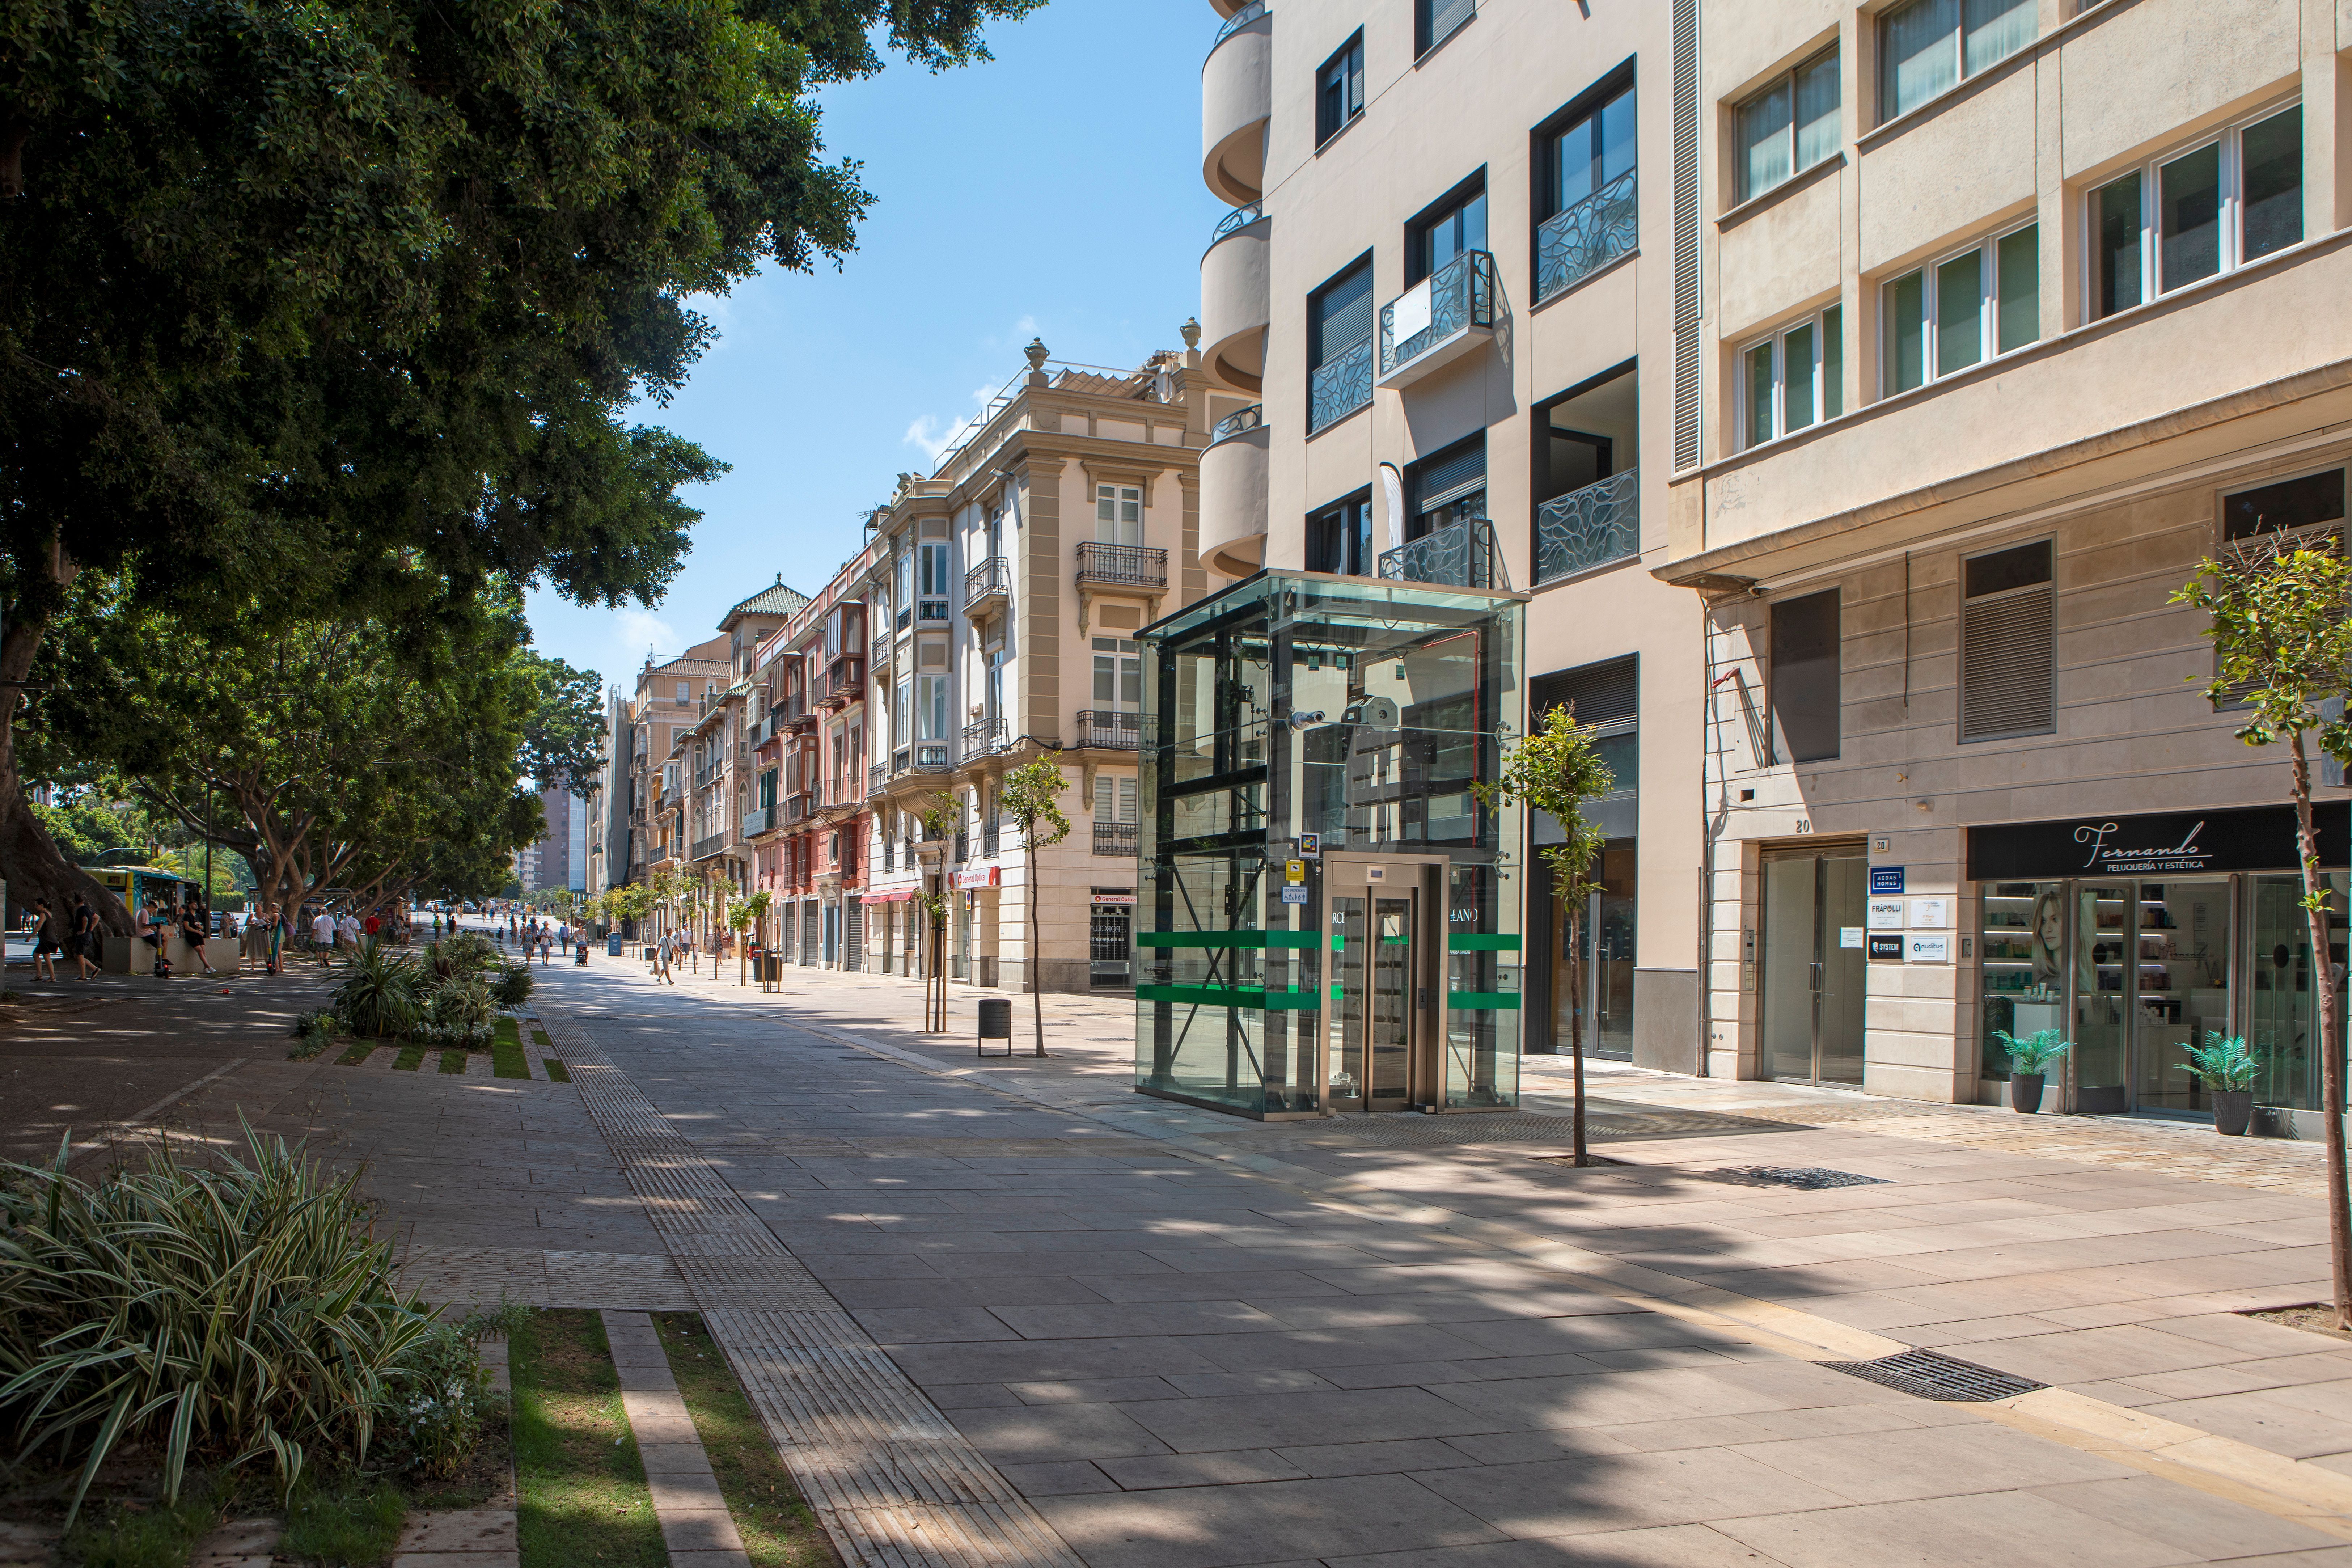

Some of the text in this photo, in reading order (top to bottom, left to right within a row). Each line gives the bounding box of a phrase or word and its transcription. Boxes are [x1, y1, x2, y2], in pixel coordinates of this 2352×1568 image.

[1796, 820, 1809, 833] 20
[2074, 821, 2204, 867] Fernando
[2107, 860, 2156, 871] PELUQUERÍA
[2165, 859, 2203, 869] ESTÉTICA
[963, 874, 974, 883] General
[1332, 912, 1345, 923] RCE
